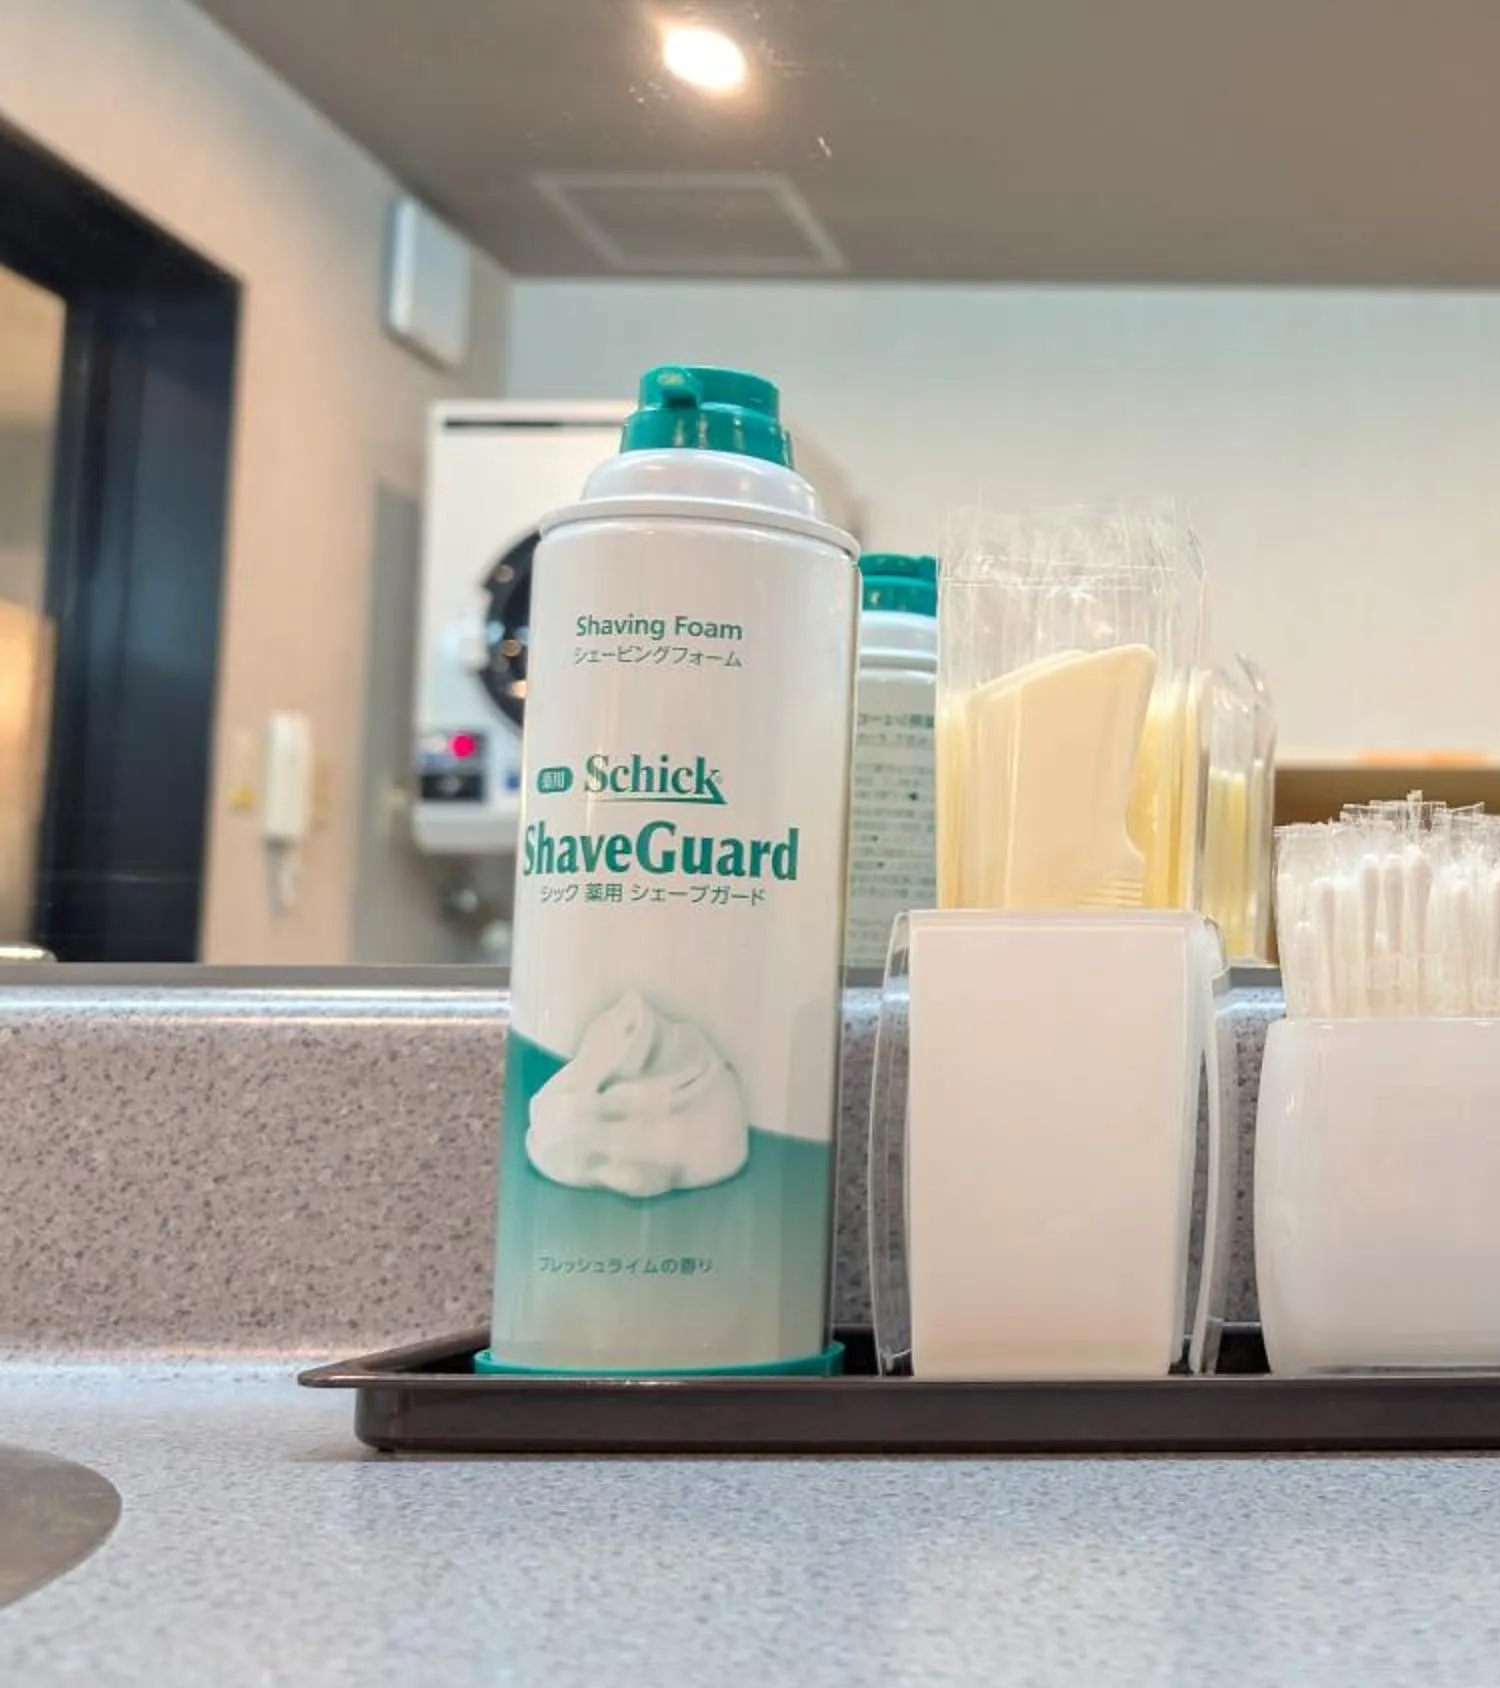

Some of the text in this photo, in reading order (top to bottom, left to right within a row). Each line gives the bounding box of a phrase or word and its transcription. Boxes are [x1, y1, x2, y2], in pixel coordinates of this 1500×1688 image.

[575, 613, 743, 641] Shaving Foam
[574, 645, 743, 668] シェービングフォーム
[584, 754, 724, 804] Schick
[523, 820, 800, 881] ShaveGuard
[541, 882, 766, 907] シック 薬用 シェーブガード
[538, 1256, 714, 1275] フレッシュライムの香り
